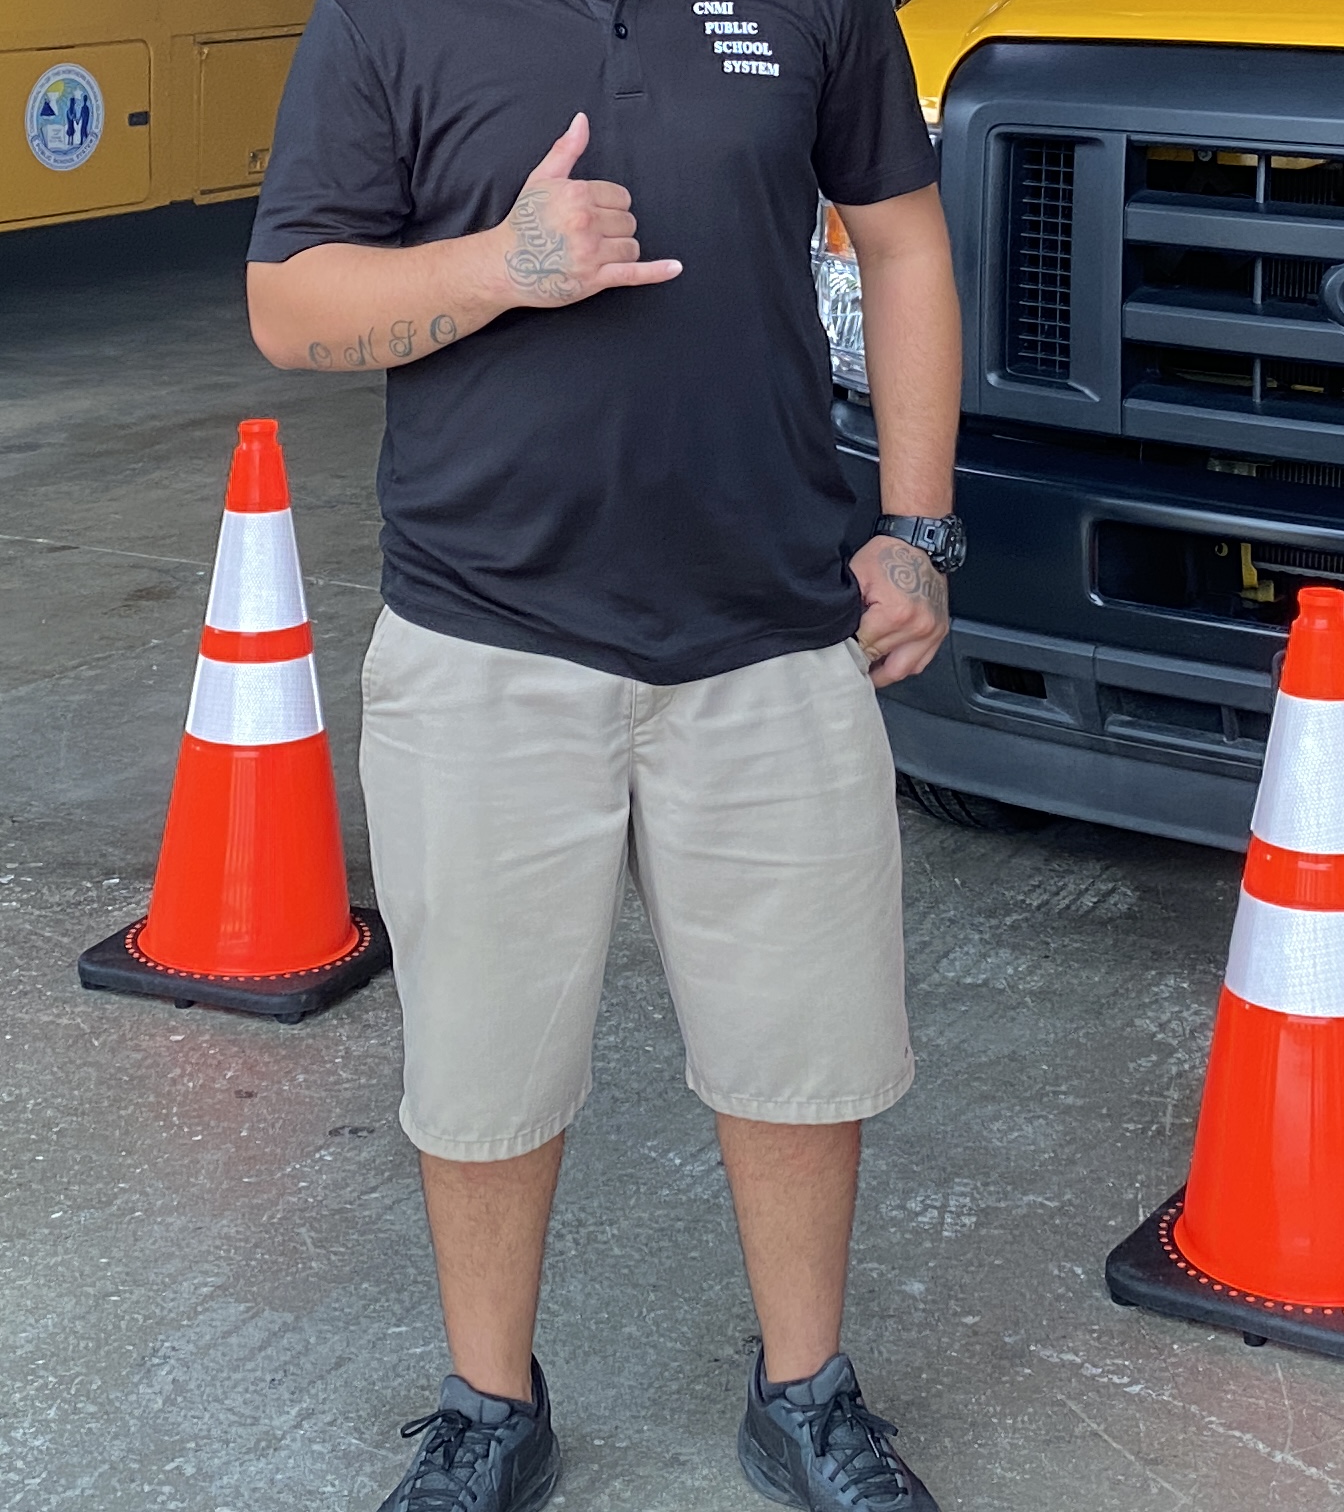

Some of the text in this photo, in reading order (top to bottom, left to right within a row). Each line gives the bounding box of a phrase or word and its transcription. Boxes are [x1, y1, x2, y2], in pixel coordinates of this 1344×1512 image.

[693, 1, 734, 15] CNMI
[704, 21, 759, 35] PUBLIC
[714, 40, 773, 56] SCHOOL
[723, 60, 780, 77] SYSTEM
